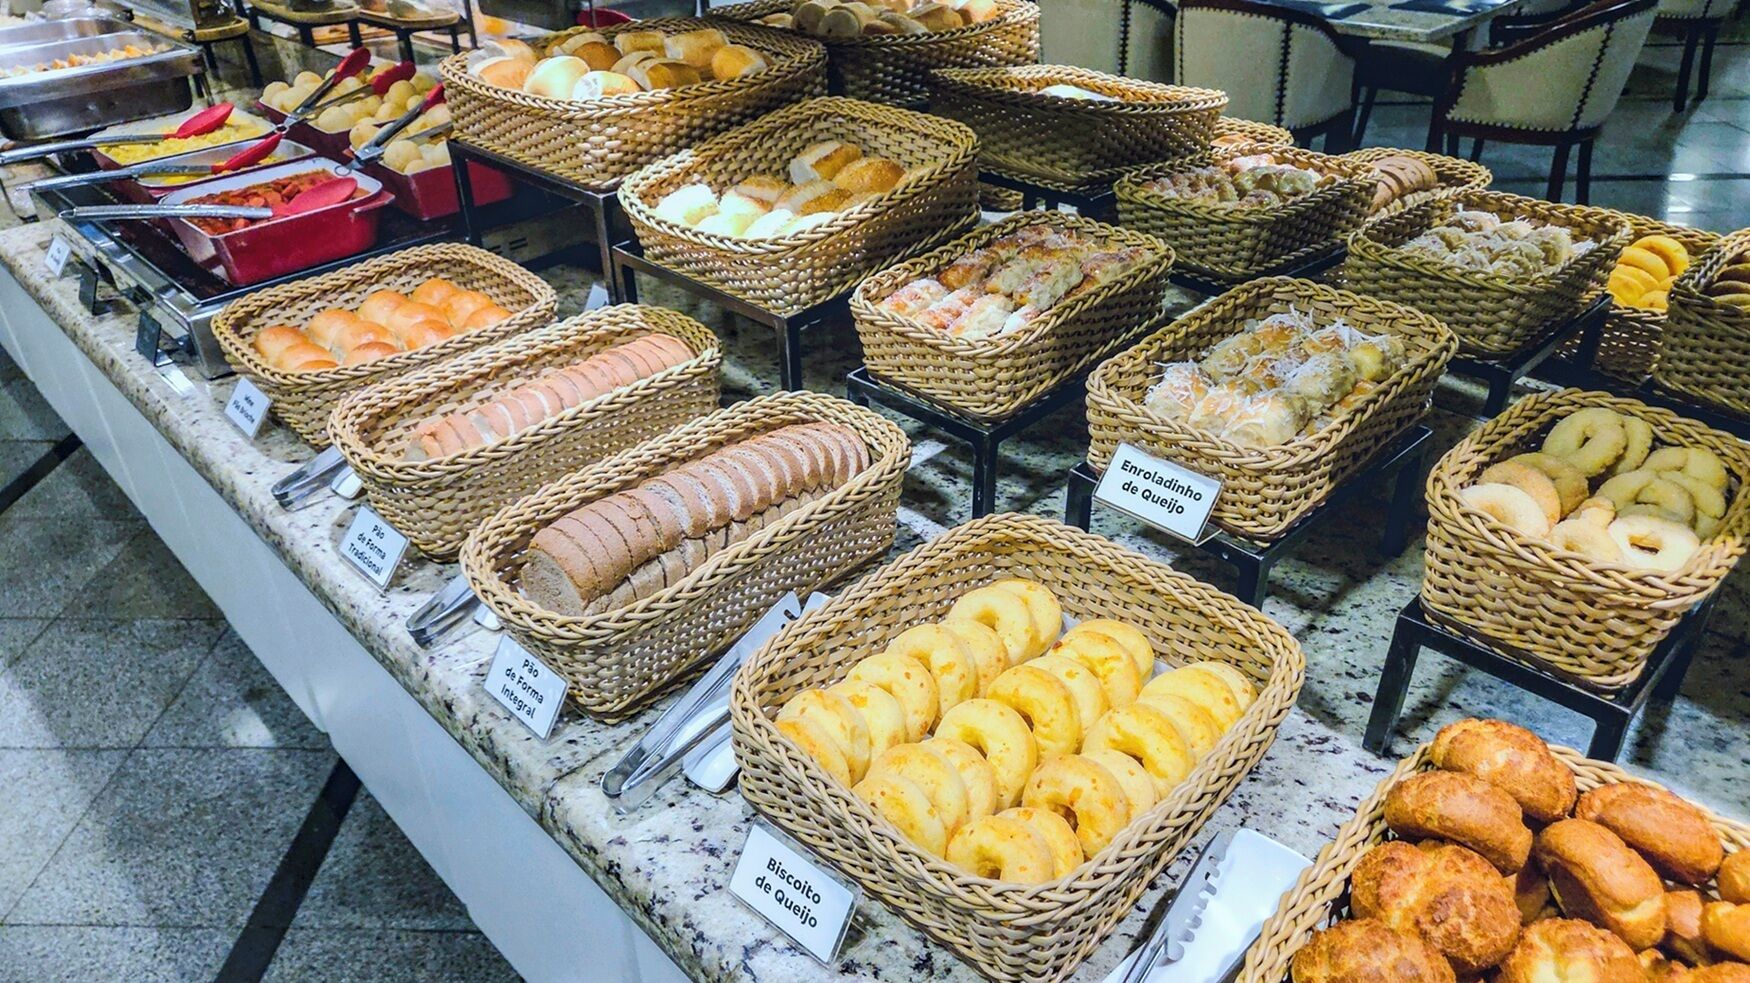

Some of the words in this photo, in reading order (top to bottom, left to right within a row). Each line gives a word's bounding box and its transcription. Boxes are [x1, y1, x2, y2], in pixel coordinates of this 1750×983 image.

[1120, 459, 1203, 501] Enroladinho
[1122, 480, 1139, 495] de
[1141, 488, 1185, 514] Queijo
[357, 532, 367, 543] de
[366, 538, 387, 560] Forma
[372, 524, 385, 540] Pão
[348, 542, 383, 576] Tradicional
[505, 667, 516, 681] de
[516, 676, 544, 704] Forma
[522, 659, 539, 678] Pão
[501, 684, 537, 719] Integral
[766, 857, 821, 904] Biscoito
[755, 876, 772, 894] de
[774, 889, 818, 928] Queijo
